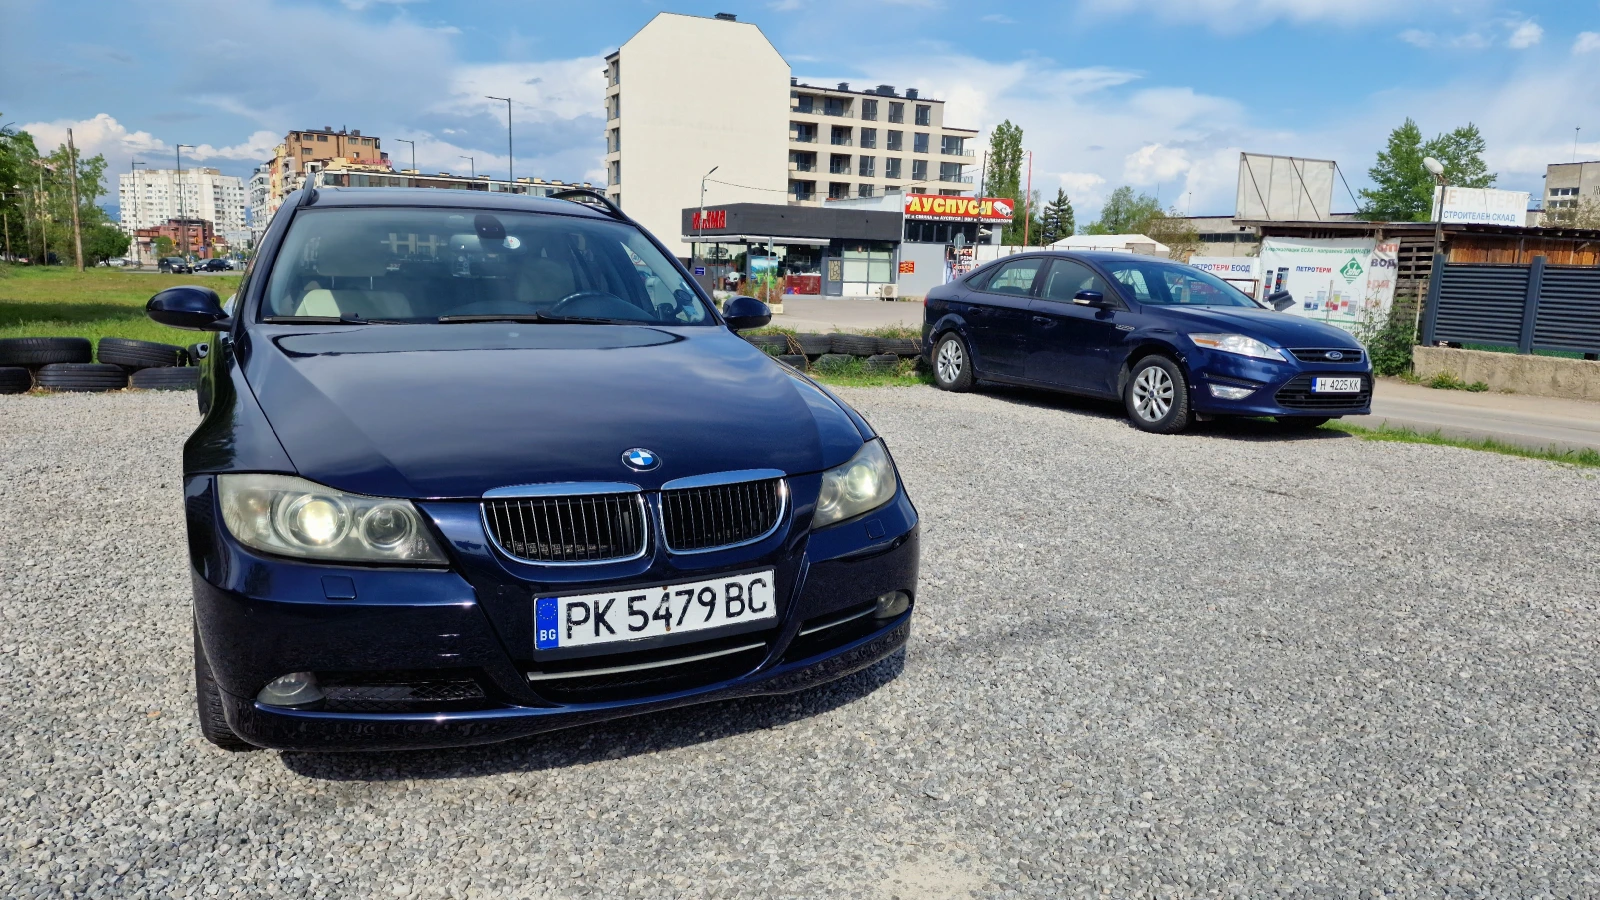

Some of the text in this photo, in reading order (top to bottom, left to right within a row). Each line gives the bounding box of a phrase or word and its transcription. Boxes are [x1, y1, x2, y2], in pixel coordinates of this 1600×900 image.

[909, 196, 993, 216] АУСПУСИ
[1443, 210, 1516, 223] СТРОИТЕЛЕН СКЛАД
[1231, 264, 1250, 273] ЕООД
[1320, 380, 1326, 390] H
[566, 578, 767, 639] PK 5479 BC
[540, 629, 556, 641] BG
